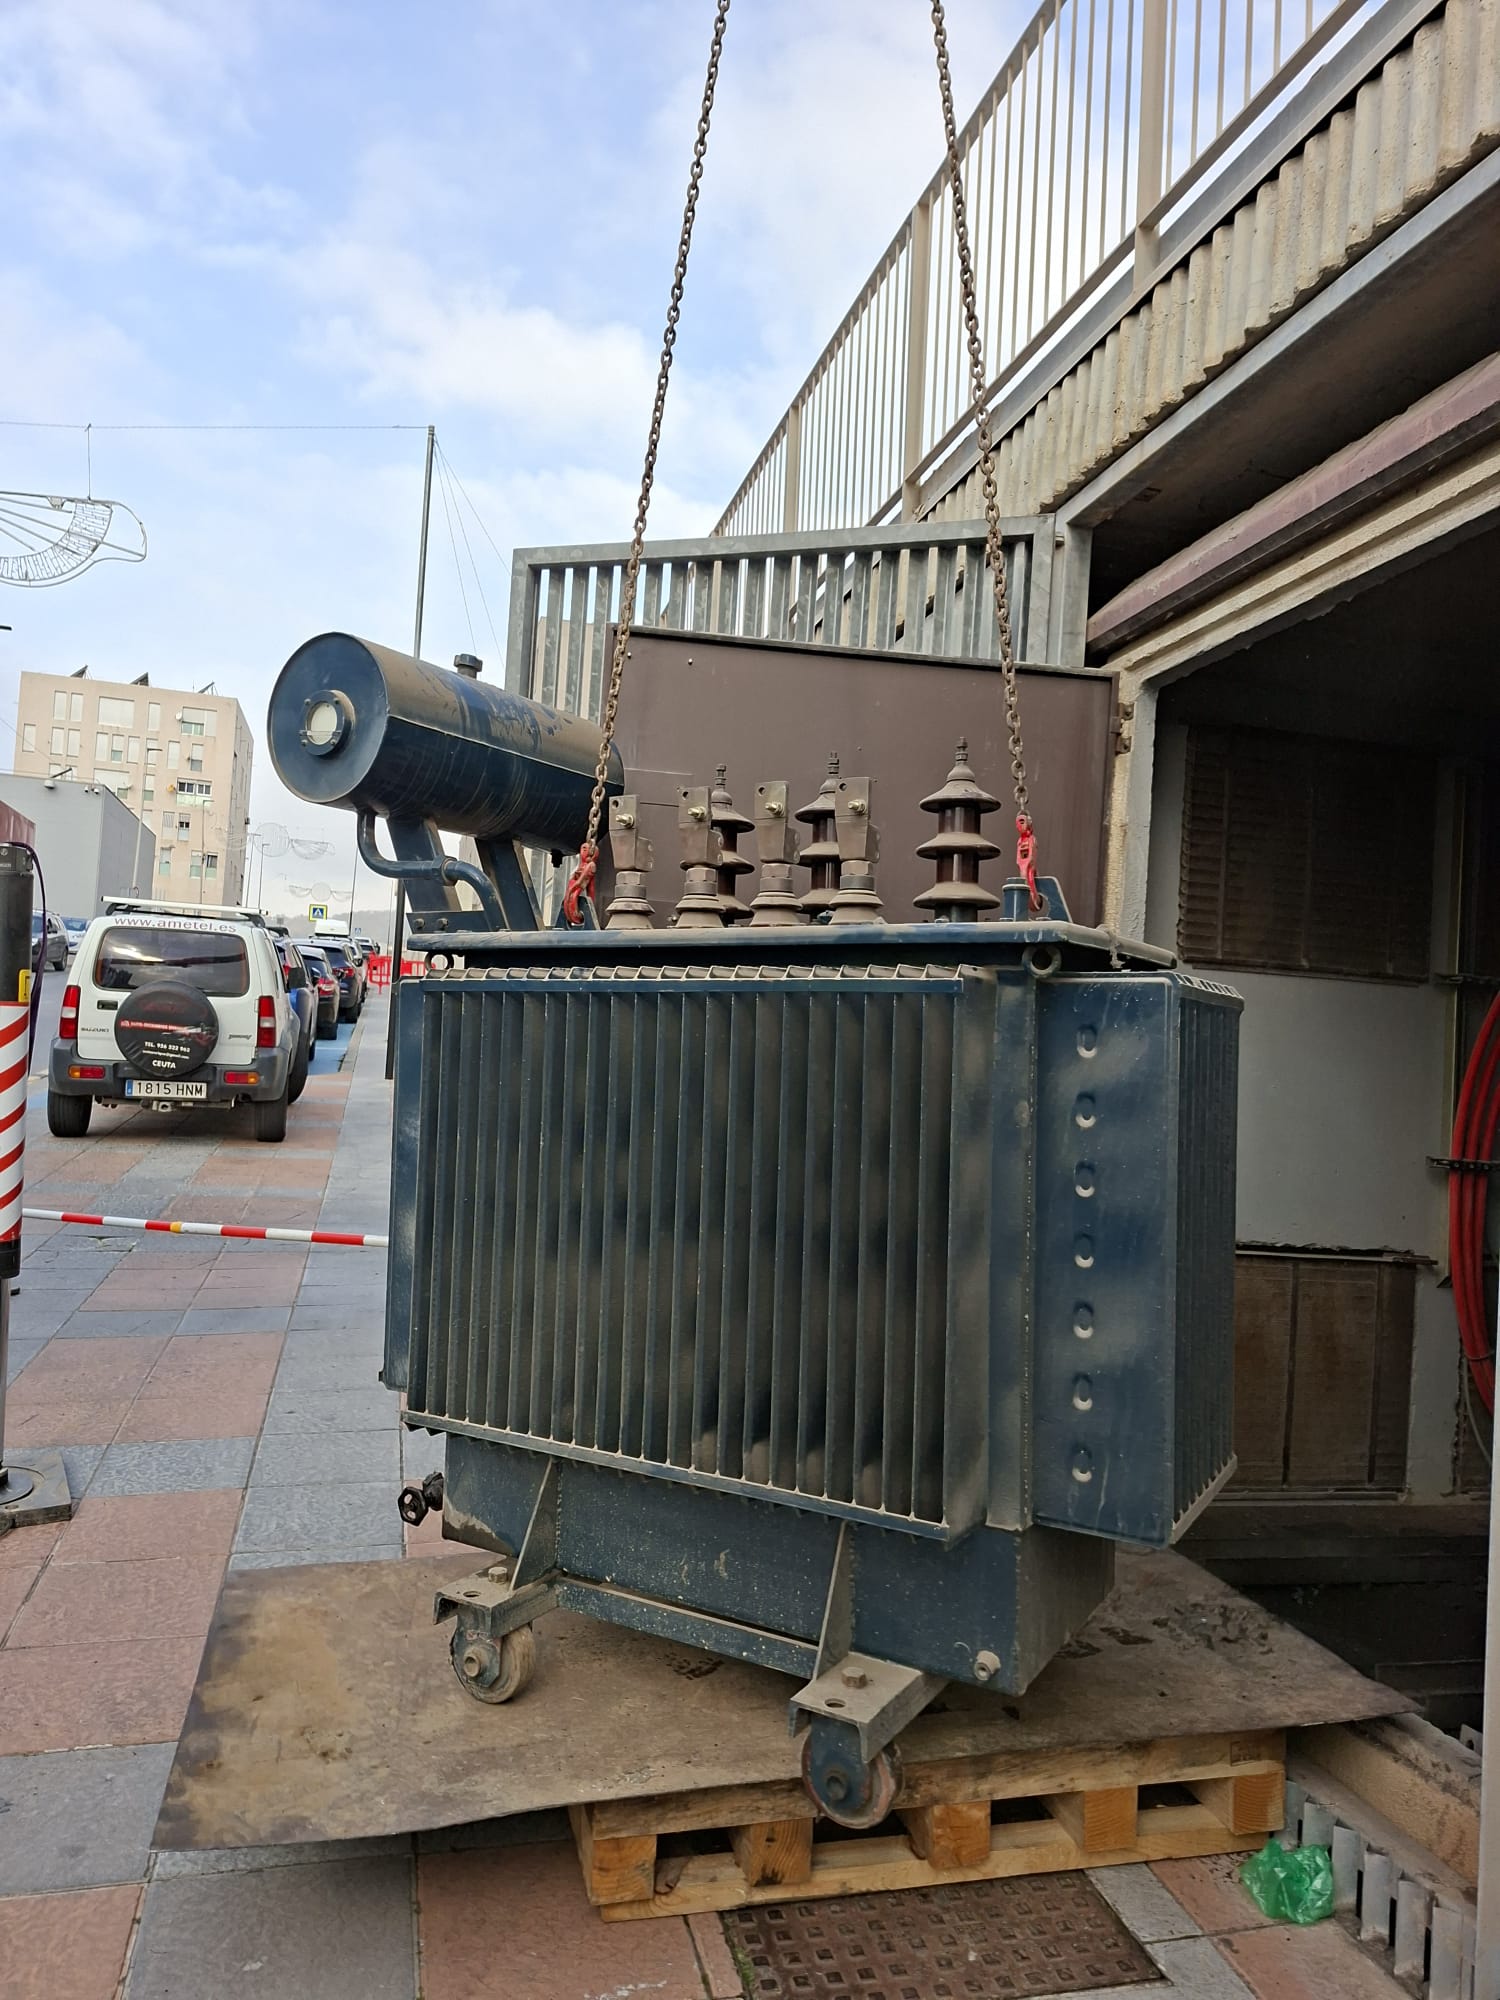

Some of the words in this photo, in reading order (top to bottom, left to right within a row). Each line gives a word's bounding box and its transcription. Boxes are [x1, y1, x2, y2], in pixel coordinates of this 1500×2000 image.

[114, 917, 237, 933] www.ametel.es
[152, 1060, 176, 1069] CEUTA
[137, 1082, 171, 1095] 1815
[176, 1083, 203, 1096] HNM
